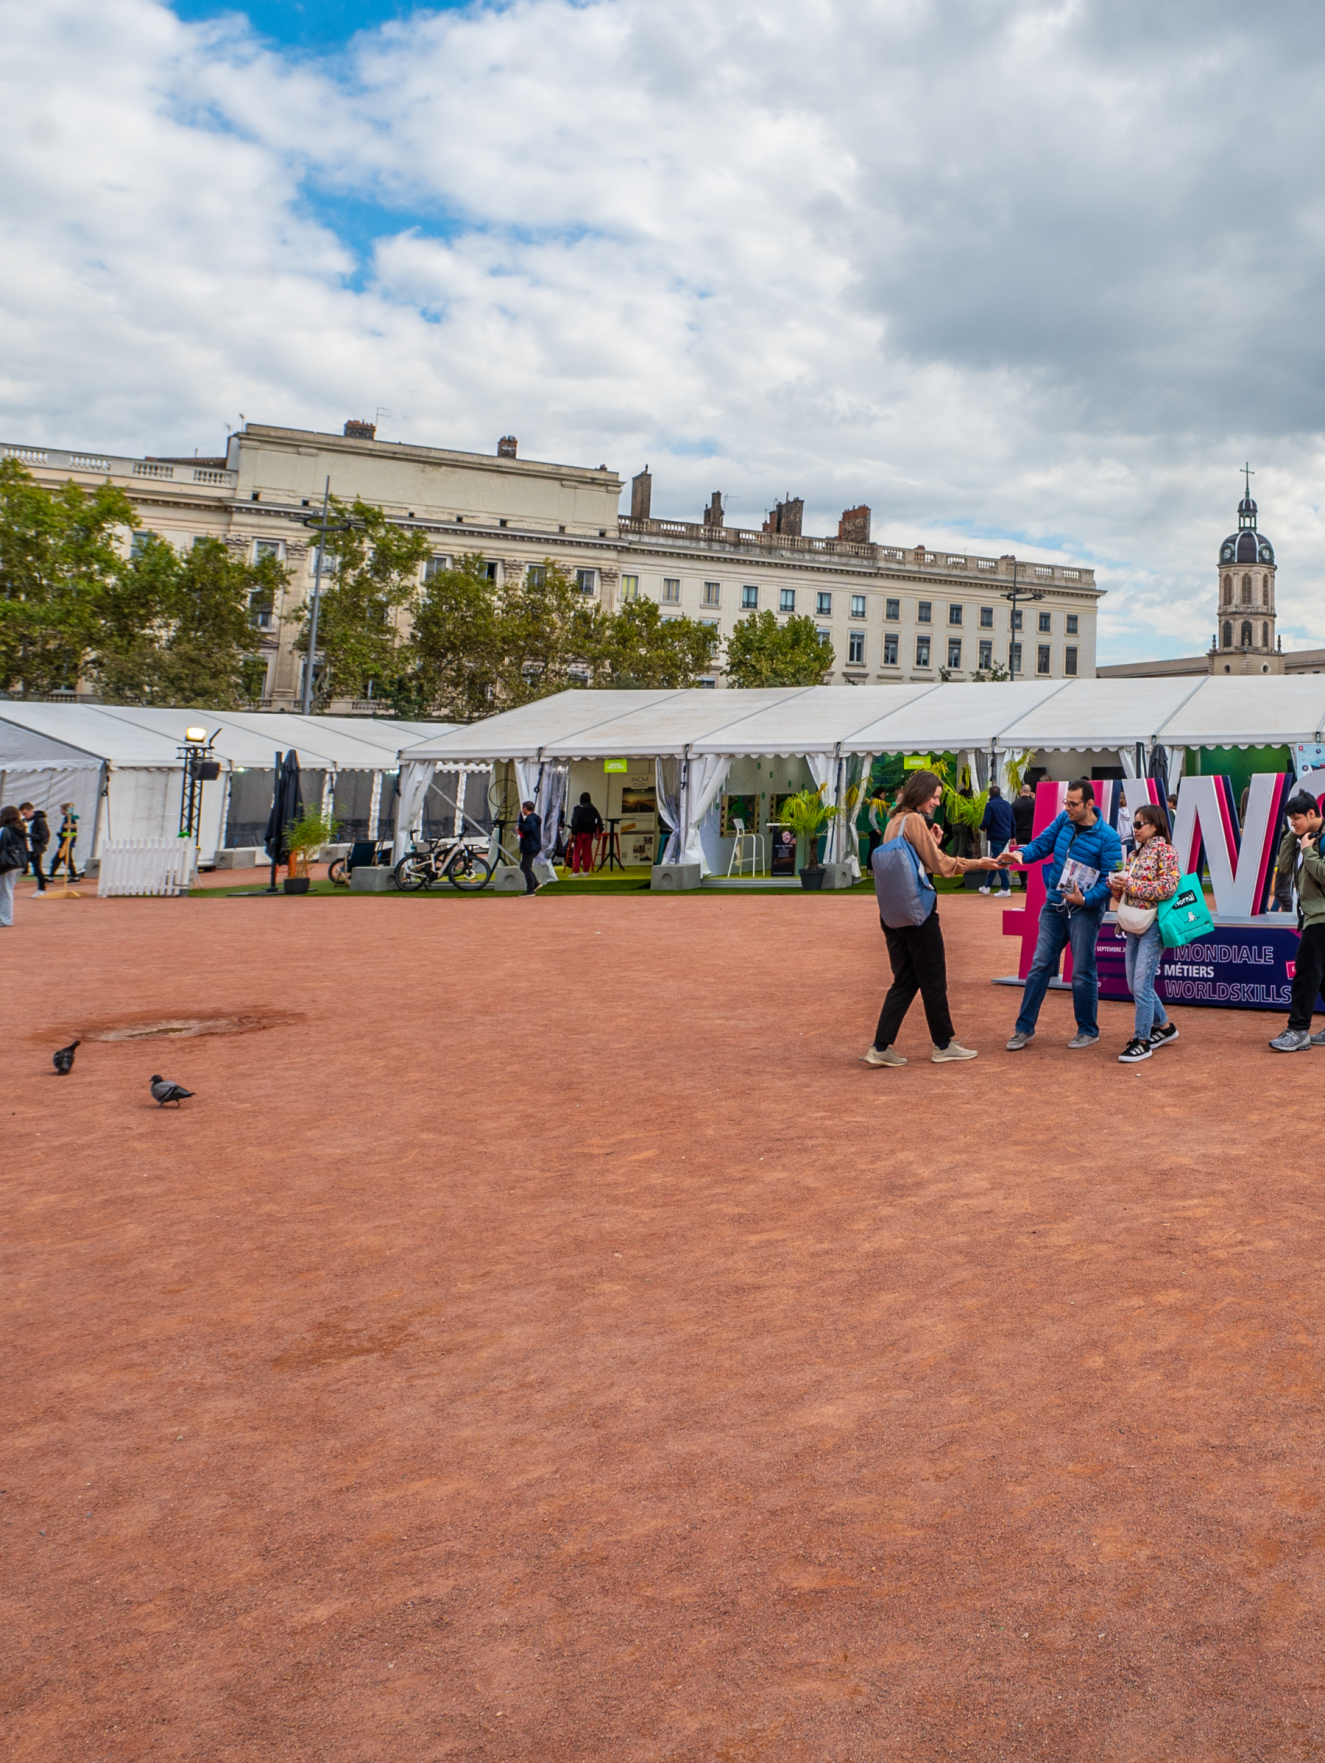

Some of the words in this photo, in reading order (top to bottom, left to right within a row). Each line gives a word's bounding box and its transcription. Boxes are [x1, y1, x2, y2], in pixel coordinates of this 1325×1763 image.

[1096, 945, 1122, 953] SEPTEMBRE
[1173, 943, 1274, 965] MONDIALE
[1164, 962, 1214, 978] MÉTIERS
[1164, 979, 1292, 1004] WORLDSKILLS
